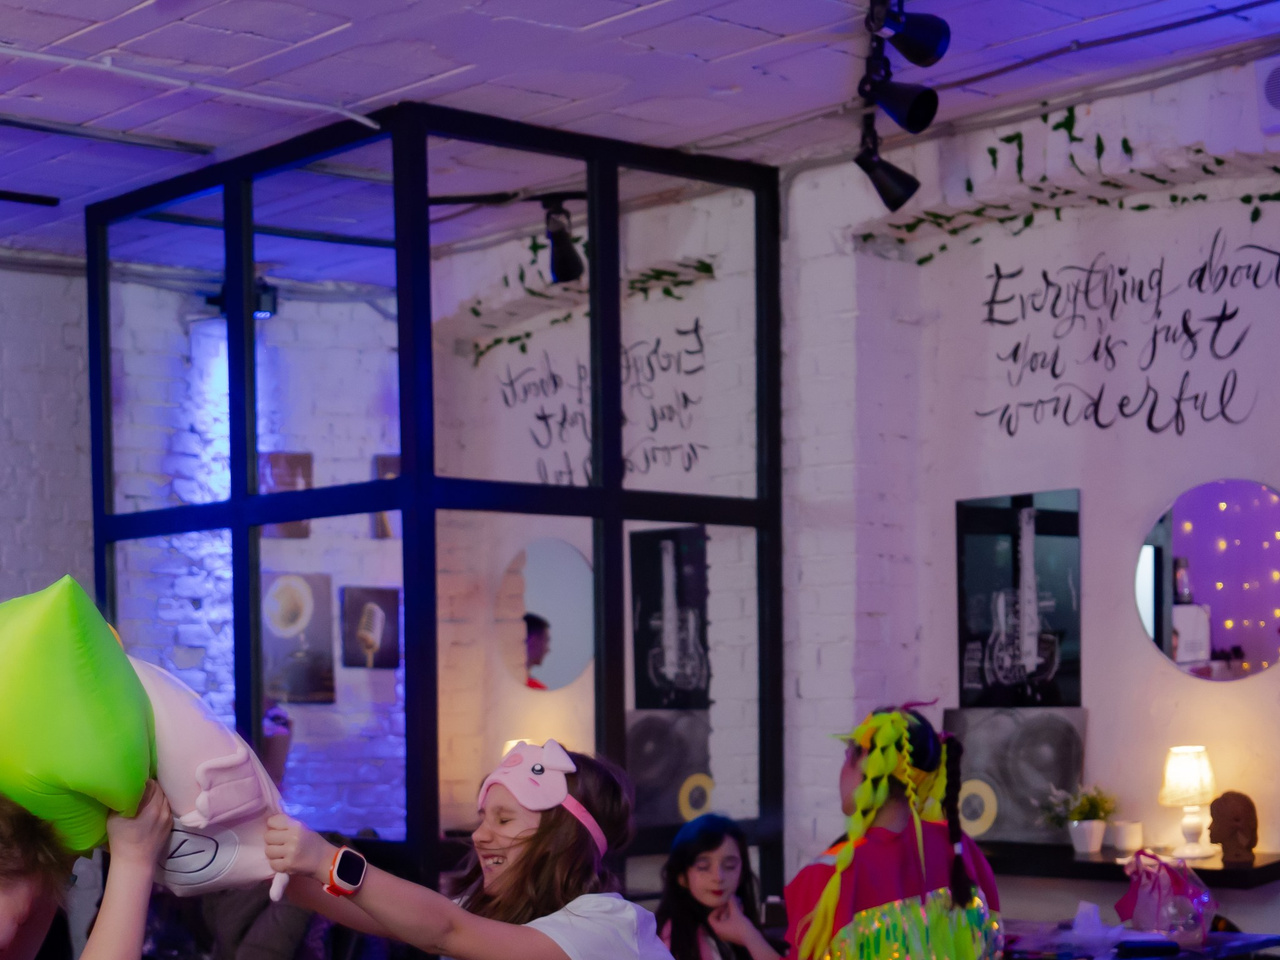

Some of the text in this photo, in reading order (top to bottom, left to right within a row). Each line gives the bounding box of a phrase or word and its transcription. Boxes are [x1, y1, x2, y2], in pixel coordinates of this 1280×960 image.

[982, 252, 1175, 339] Everything
[1078, 317, 1128, 371] is
[1138, 300, 1251, 371] just
[975, 368, 1257, 437] wonderful
